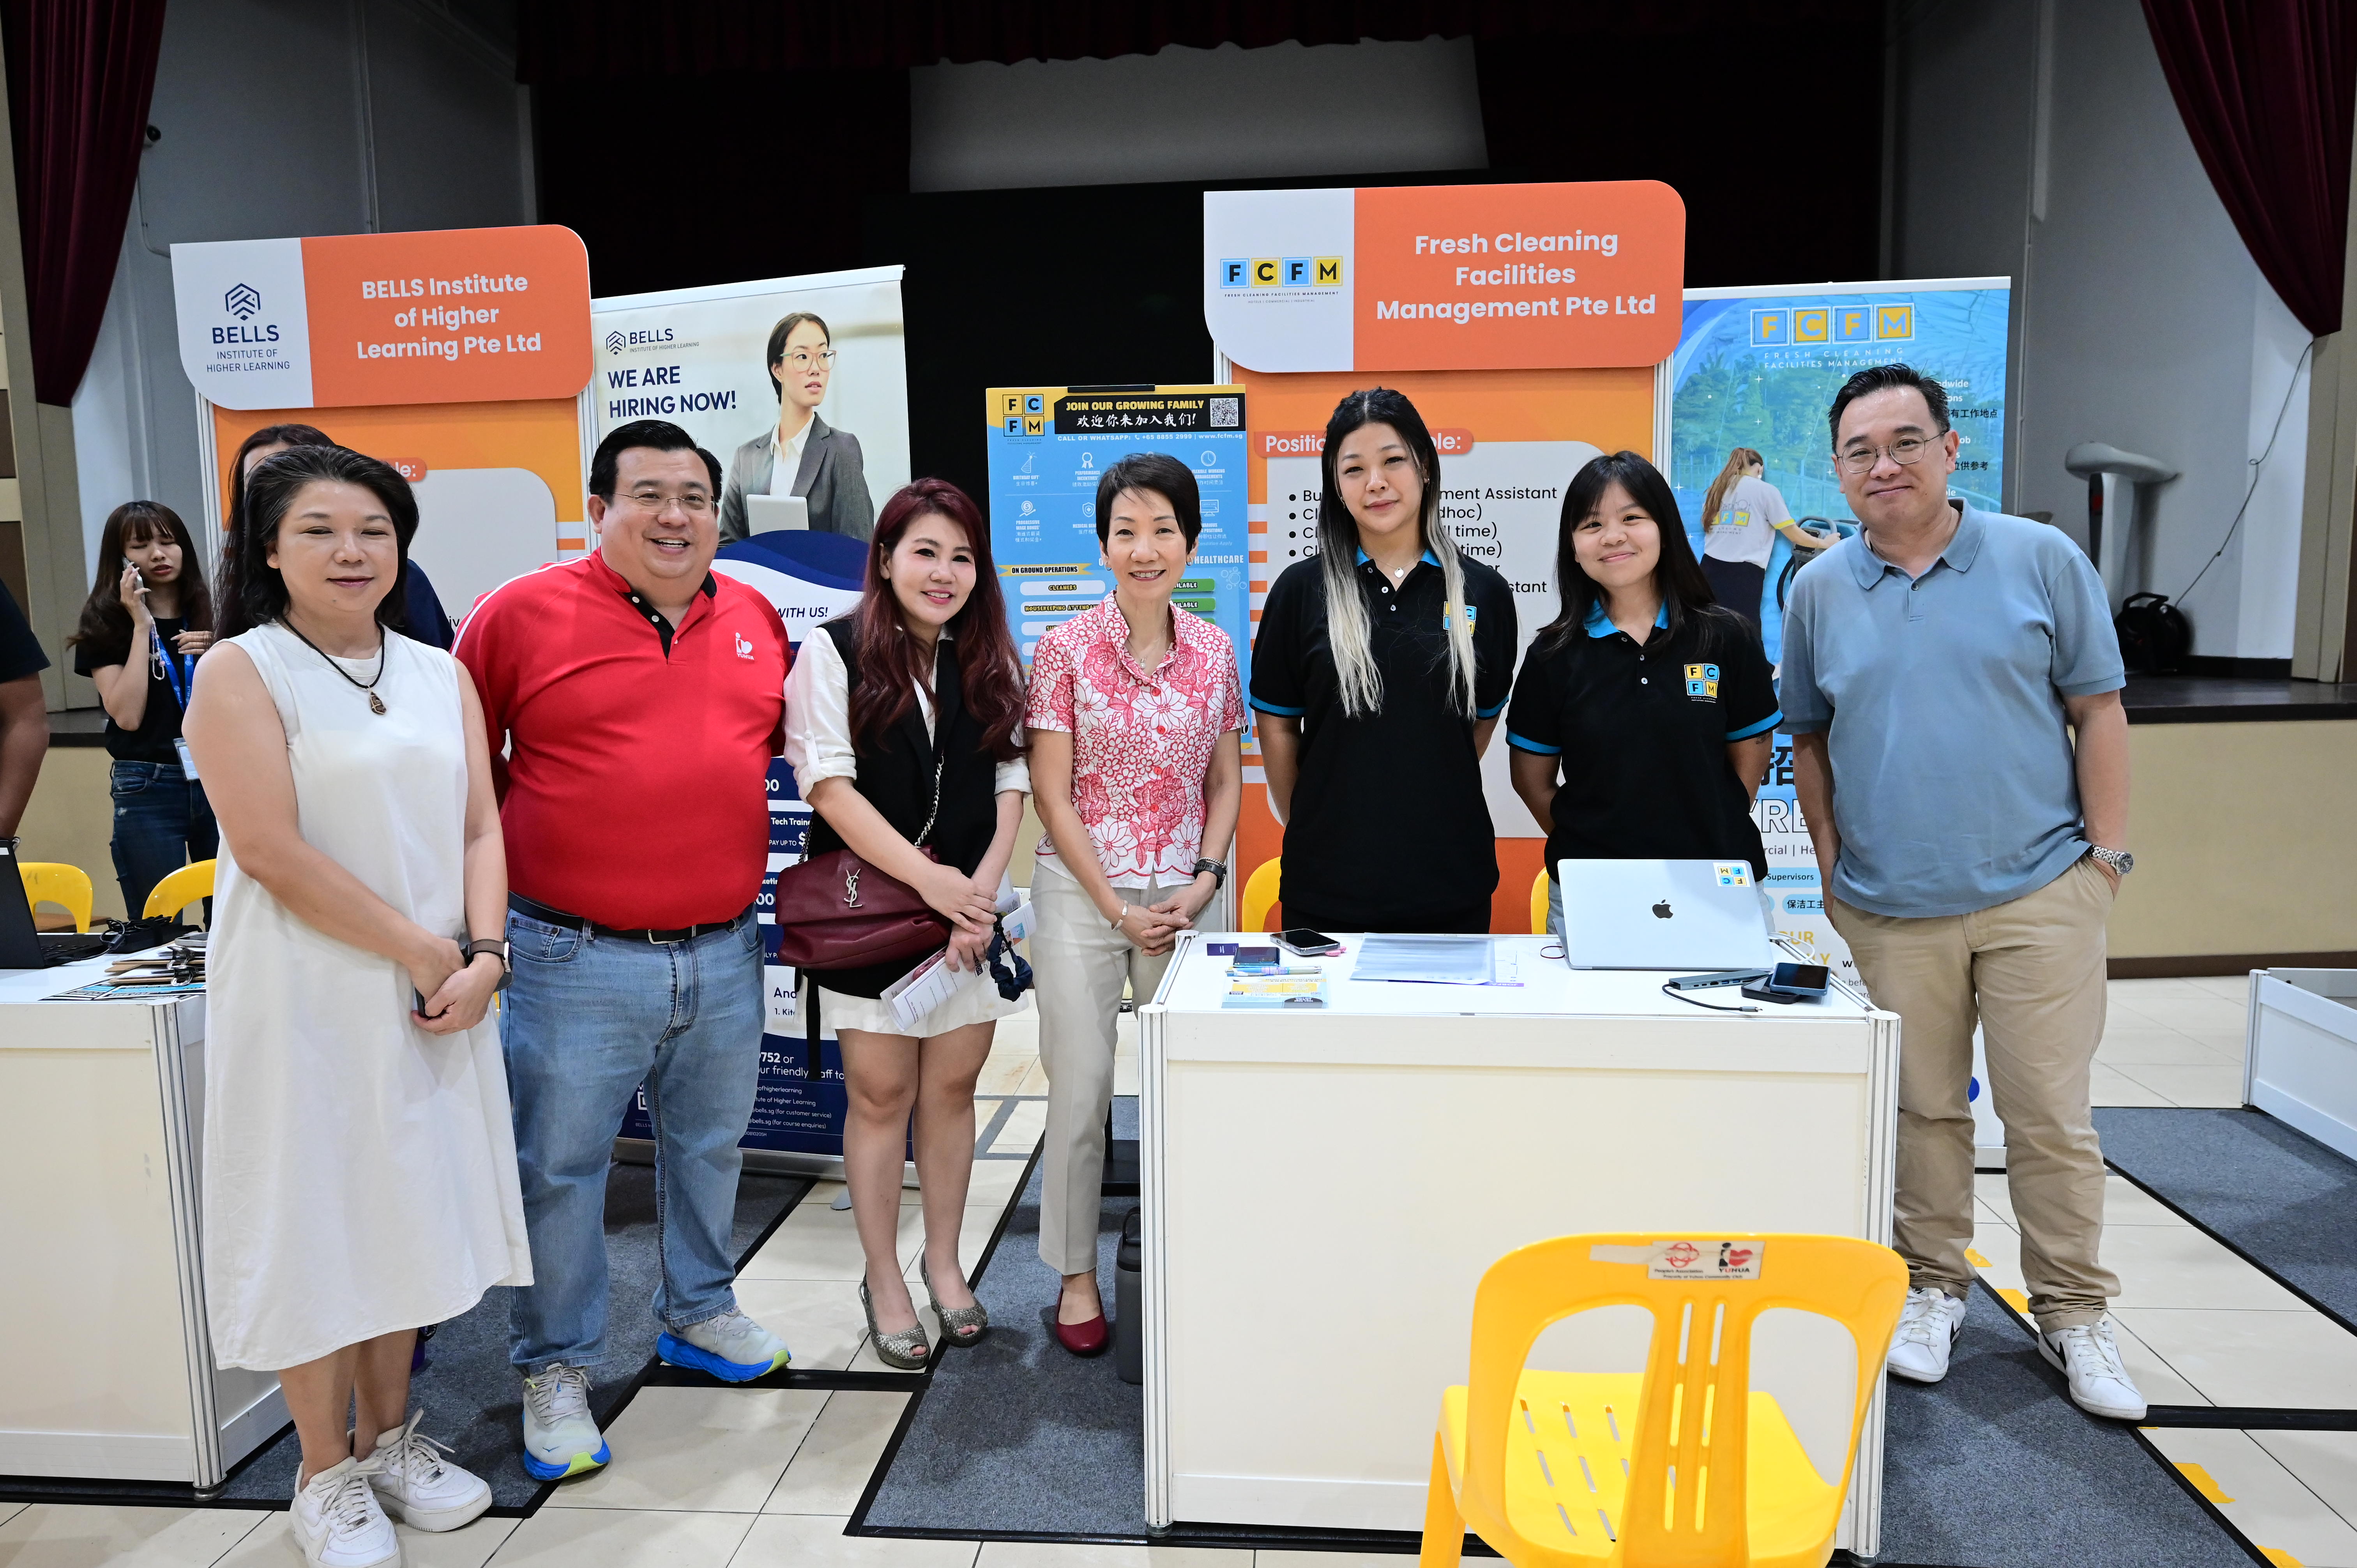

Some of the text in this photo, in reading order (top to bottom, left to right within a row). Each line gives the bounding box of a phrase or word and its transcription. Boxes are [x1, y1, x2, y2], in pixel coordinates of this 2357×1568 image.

[1415, 231, 1618, 256] Fresh Cleaning
[1456, 263, 1575, 286] Facilities
[362, 274, 528, 299] BELLS Institute
[1376, 293, 1656, 325] Management Pte Ltd
[394, 305, 498, 331] of Higher
[212, 325, 279, 344] BELLS
[630, 328, 673, 344] BELLS
[357, 332, 541, 361] Learning Pte Ltd
[1824, 348, 1903, 357] CLEANING
[217, 350, 277, 360] INSTITUTE OF
[1765, 357, 1903, 369] FACILITIES MANAGEMENT
[207, 360, 290, 373] HIGHER LEARNING
[608, 366, 680, 389] WE ARE
[610, 390, 736, 418] HIRING NOW!
[1066, 400, 1204, 411] JOIN OUR GROWING FAMILY
[1485, 487, 1557, 500] Assistant
[1439, 506, 1482, 522] dhoc)
[1456, 522, 1497, 540] time)
[1461, 541, 1502, 558] time)
[1194, 555, 1244, 564] HEALTHCARE
[809, 607, 828, 617] US!
[1767, 873, 1814, 882] Supervisors
[760, 1052, 780, 1063] 752
[772, 1066, 809, 1079] friendly
[835, 1071, 844, 1079] to
[793, 1099, 816, 1107] Learning
